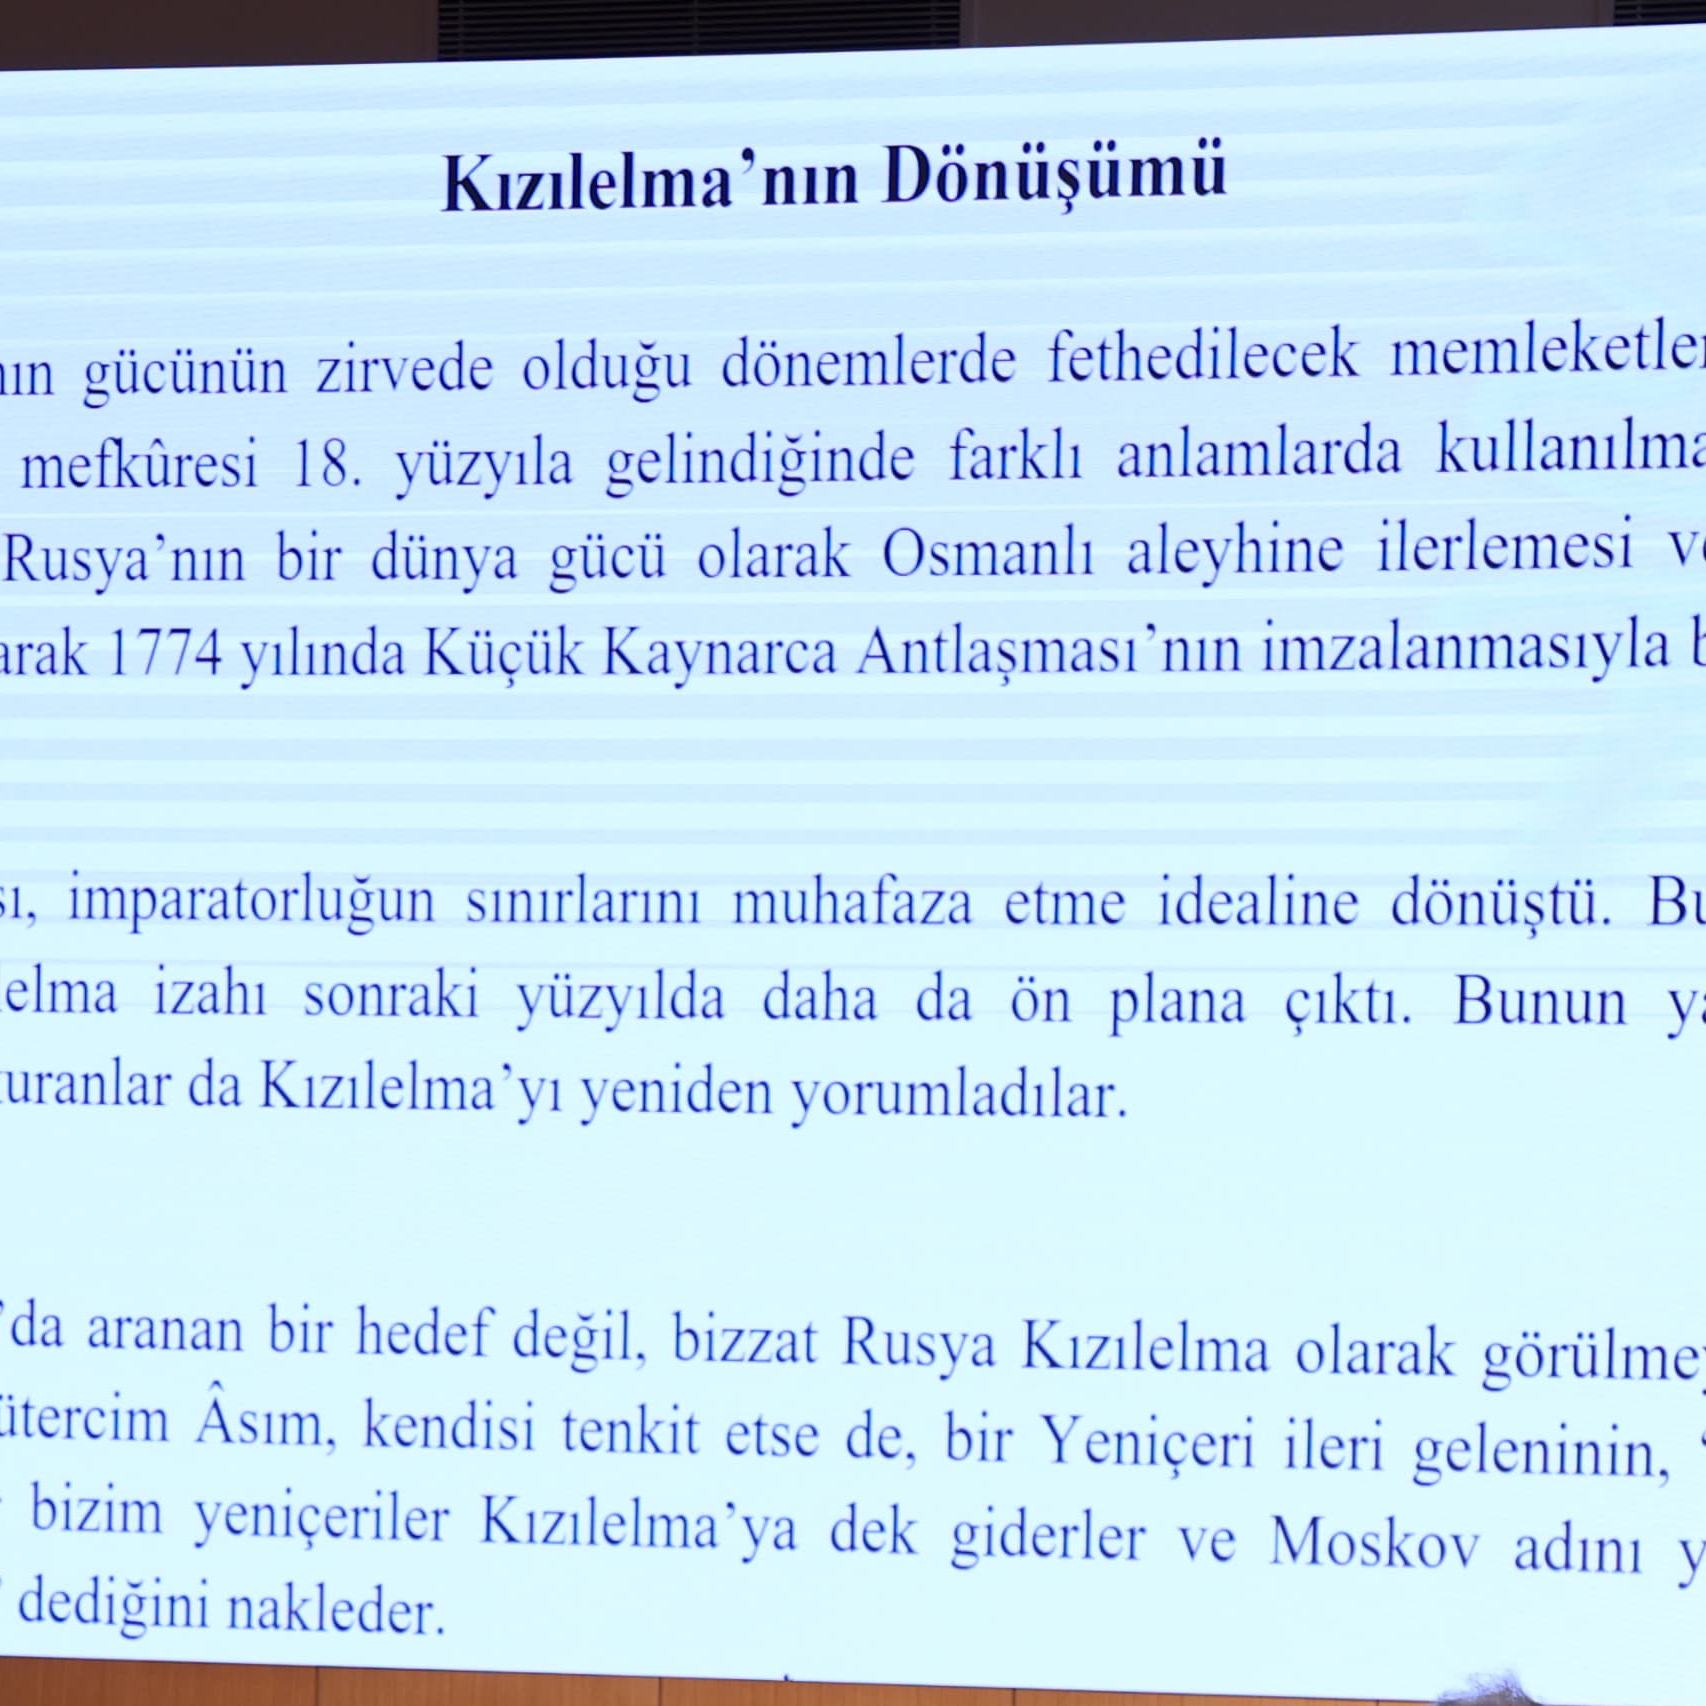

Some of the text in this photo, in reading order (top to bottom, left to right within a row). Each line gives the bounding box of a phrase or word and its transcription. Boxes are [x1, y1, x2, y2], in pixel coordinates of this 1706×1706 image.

[439, 135, 1228, 216] Kızılelma’nın Dönüşümü
[81, 346, 289, 411] gücünün
[315, 337, 495, 394] zirvede
[522, 336, 693, 405] olduğu
[721, 329, 1017, 389] dönemlerde
[1047, 322, 1361, 384] fethedilecek
[20, 434, 259, 490] mefkûresi
[296, 436, 362, 488] 18.
[394, 432, 574, 503] yüzyıla
[604, 427, 916, 501] gelindiğinde
[948, 425, 1083, 482] farklı
[1116, 419, 1403, 479] anlamlarda
[2, 531, 247, 597] Rusya’nın
[275, 527, 344, 582] bir
[370, 527, 519, 596] dünya
[547, 531, 667, 596] gücü
[697, 524, 852, 580] olarak
[882, 521, 1095, 578] Osmanlı
[1126, 518, 1345, 590] aleyhine
[1377, 512, 1634, 573] ilerlemesi
[112, 626, 224, 677] 1774
[239, 623, 406, 692] yılında
[424, 622, 585, 690] Küçük
[603, 625, 838, 691] Kaynarca
[854, 620, 1243, 688] Antlaşması’nın
[1262, 613, 1671, 685] imzalanmasıyla
[69, 868, 436, 938] imparatorluğun
[466, 871, 701, 925] sınırlarını
[733, 871, 973, 926] muhafaza
[1004, 882, 1127, 927] etme
[1159, 872, 1360, 927] idealine
[1390, 872, 1612, 941] dönüştü.
[155, 962, 267, 1017] izahı
[304, 965, 479, 1019] sonraki
[515, 966, 726, 1034] yüzyılda
[762, 967, 879, 1022] daha
[915, 968, 973, 1023] da
[1010, 974, 1072, 1024] ön
[1109, 969, 1246, 1039] plana
[1284, 970, 1412, 1037] çıktı.
[1454, 973, 1627, 1026] Bunun
[187, 1055, 243, 1108] da
[260, 1058, 562, 1127] Kızılelma’yı
[579, 1060, 773, 1128] yeniden
[790, 1064, 1127, 1131] yorumladılar.
[87, 1314, 244, 1353] aranan
[268, 1301, 335, 1355] bir
[356, 1303, 498, 1358] hedef
[512, 1306, 647, 1375] değil,
[672, 1309, 818, 1365] bizzat
[843, 1314, 997, 1383] Rusya
[1023, 1317, 1270, 1374] Kızılelma
[1295, 1321, 1456, 1378] olarak
[195, 1378, 337, 1455] Âsım,
[364, 1396, 534, 1452] kendisi
[561, 1402, 700, 1456] tenkit
[725, 1416, 820, 1458] etse
[845, 1406, 917, 1468] de,
[945, 1409, 1015, 1463] bir
[1040, 1412, 1254, 1480] Yeniçeri
[1285, 1415, 1383, 1472] ileri
[1411, 1420, 1670, 1494] geleninin,
[31, 1479, 163, 1535] bizim
[193, 1486, 452, 1551] yeniçeriler
[482, 1494, 798, 1566] Kızılelma’ya
[829, 1501, 918, 1556] dek
[949, 1504, 1148, 1572] giderler
[1178, 1526, 1237, 1564] ve
[1272, 1513, 1481, 1569] Moskov
[1513, 1518, 1641, 1575] adını
[17, 1572, 209, 1642] dediğini
[228, 1580, 445, 1636] nakleder.
